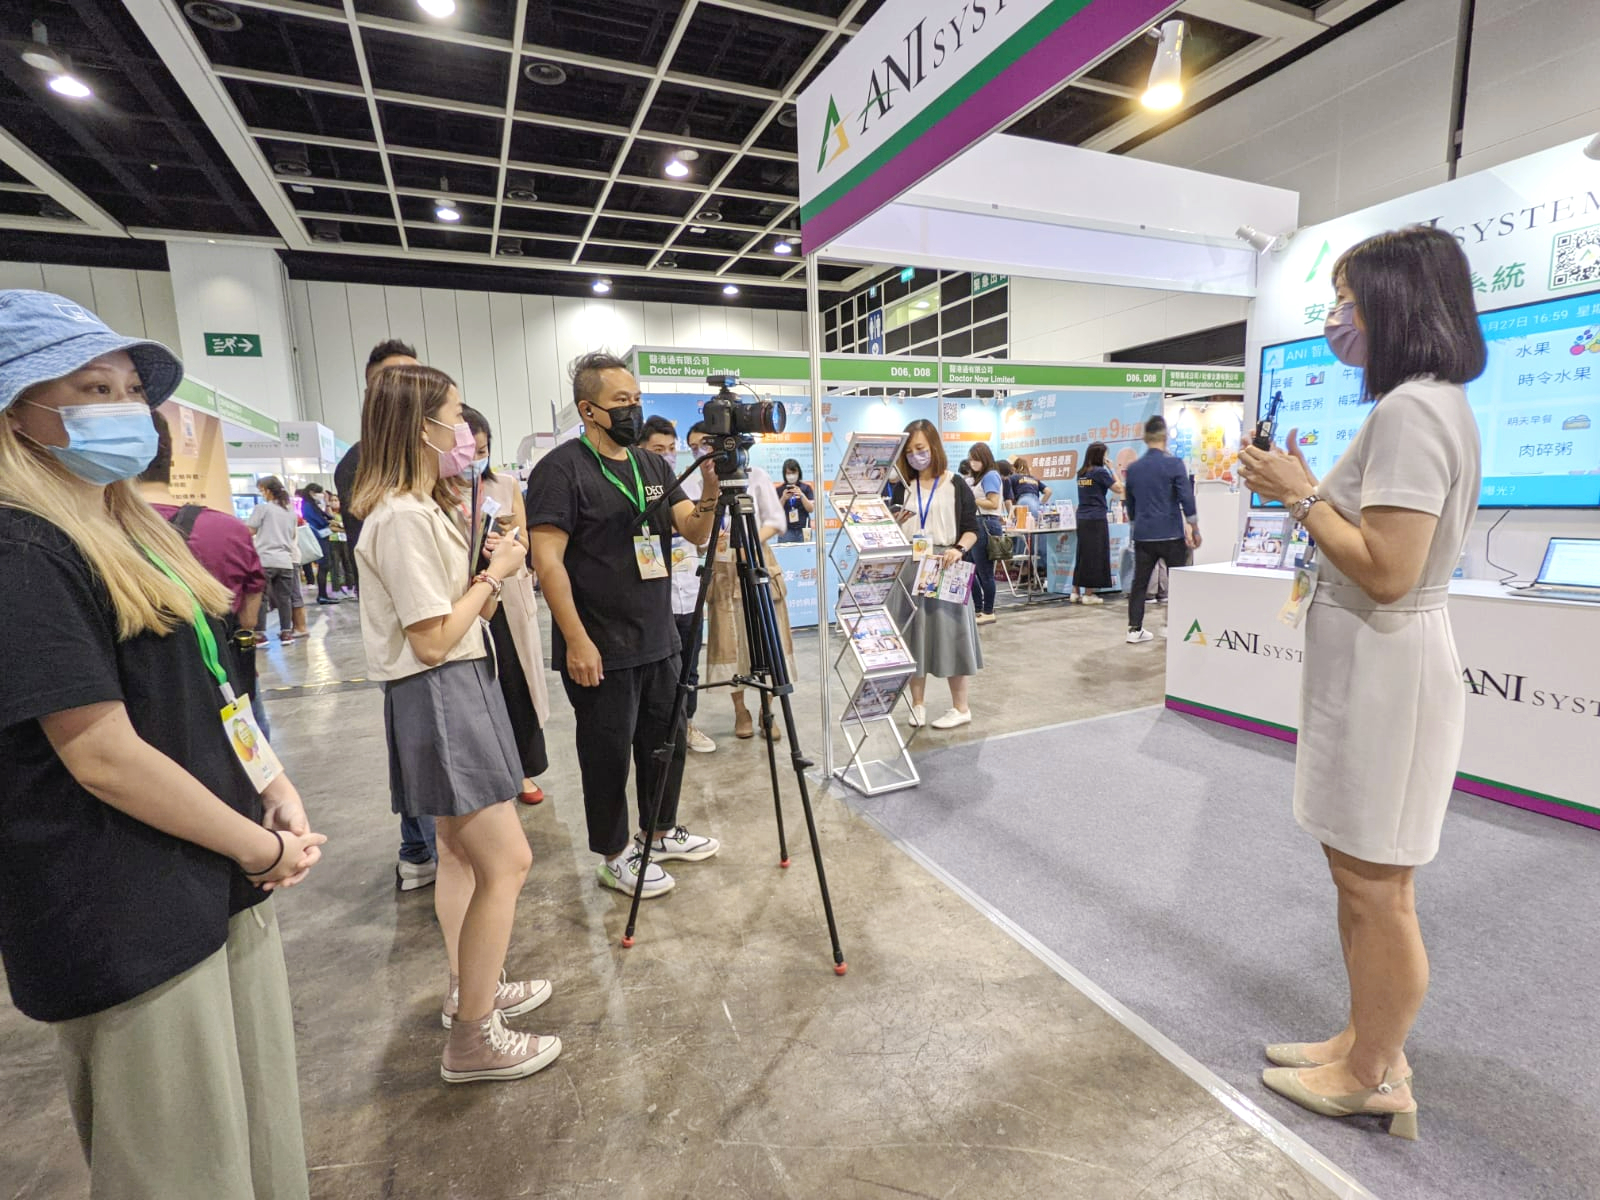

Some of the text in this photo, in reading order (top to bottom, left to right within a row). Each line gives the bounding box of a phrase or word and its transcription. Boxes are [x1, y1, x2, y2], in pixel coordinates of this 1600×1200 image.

[857, 0, 1007, 136] ANI SYS
[1533, 309, 1568, 324] 16:59
[1286, 349, 1309, 361] ANI
[1516, 342, 1551, 358] 水果
[649, 365, 740, 377] Doctor Now Limited
[891, 366, 931, 378] D06, D08
[949, 374, 1015, 384] Doctor Now Limited
[1517, 366, 1592, 387] 時令水果
[1518, 441, 1574, 458] 肉碎粥
[1213, 629, 1263, 655] ANI
[1462, 667, 1528, 704] ANI
